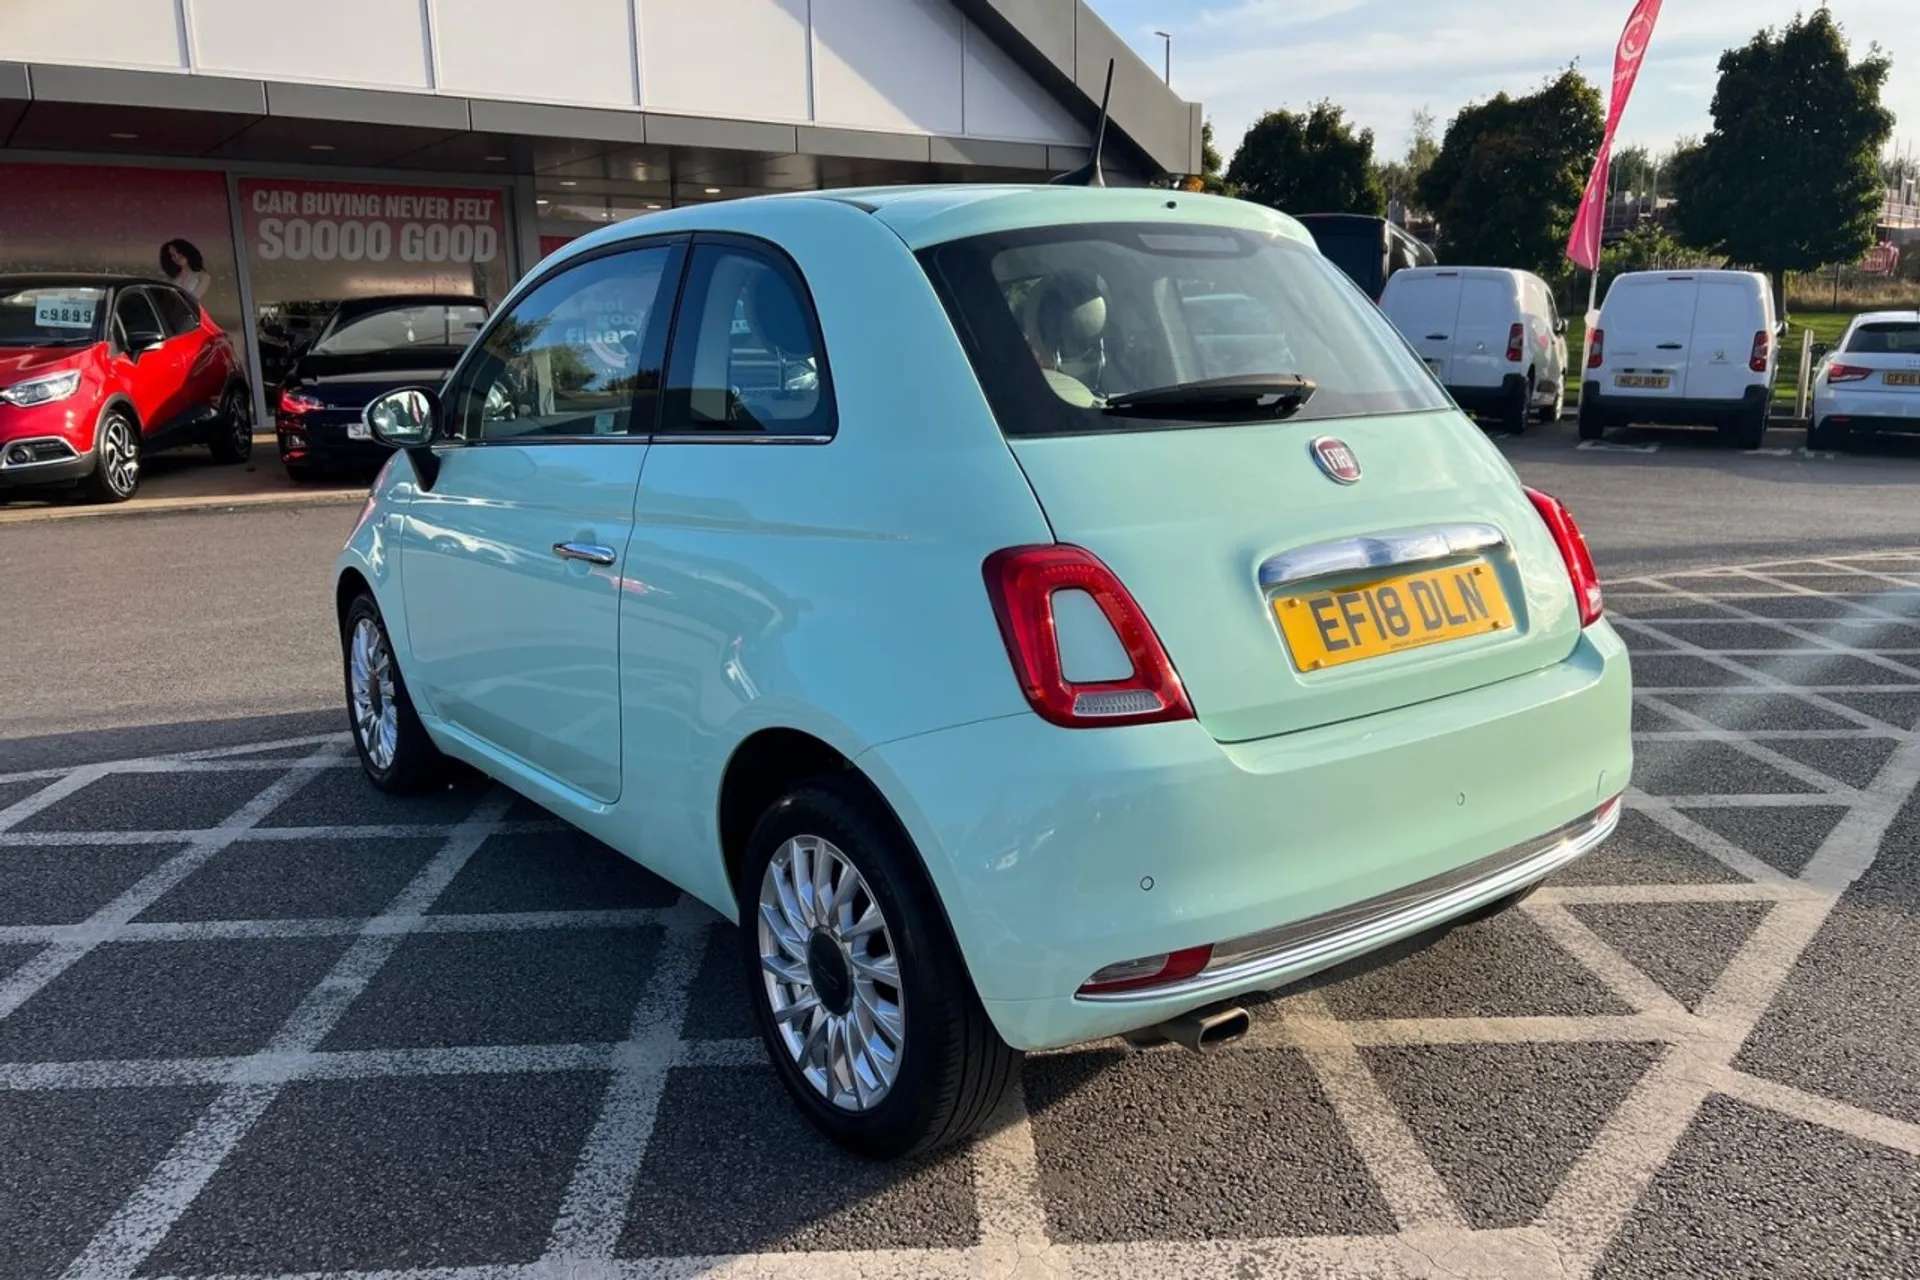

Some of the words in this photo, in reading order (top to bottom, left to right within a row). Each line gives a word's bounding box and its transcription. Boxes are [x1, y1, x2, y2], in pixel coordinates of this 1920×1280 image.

[253, 190, 297, 214] CAR
[303, 192, 380, 217] BUYING
[386, 195, 449, 220] NEVER
[453, 198, 494, 221] FELT
[258, 218, 391, 262] SOOOO
[401, 223, 497, 263] GOOD
[1308, 586, 1411, 653] EF18
[1408, 572, 1490, 631] DLN
